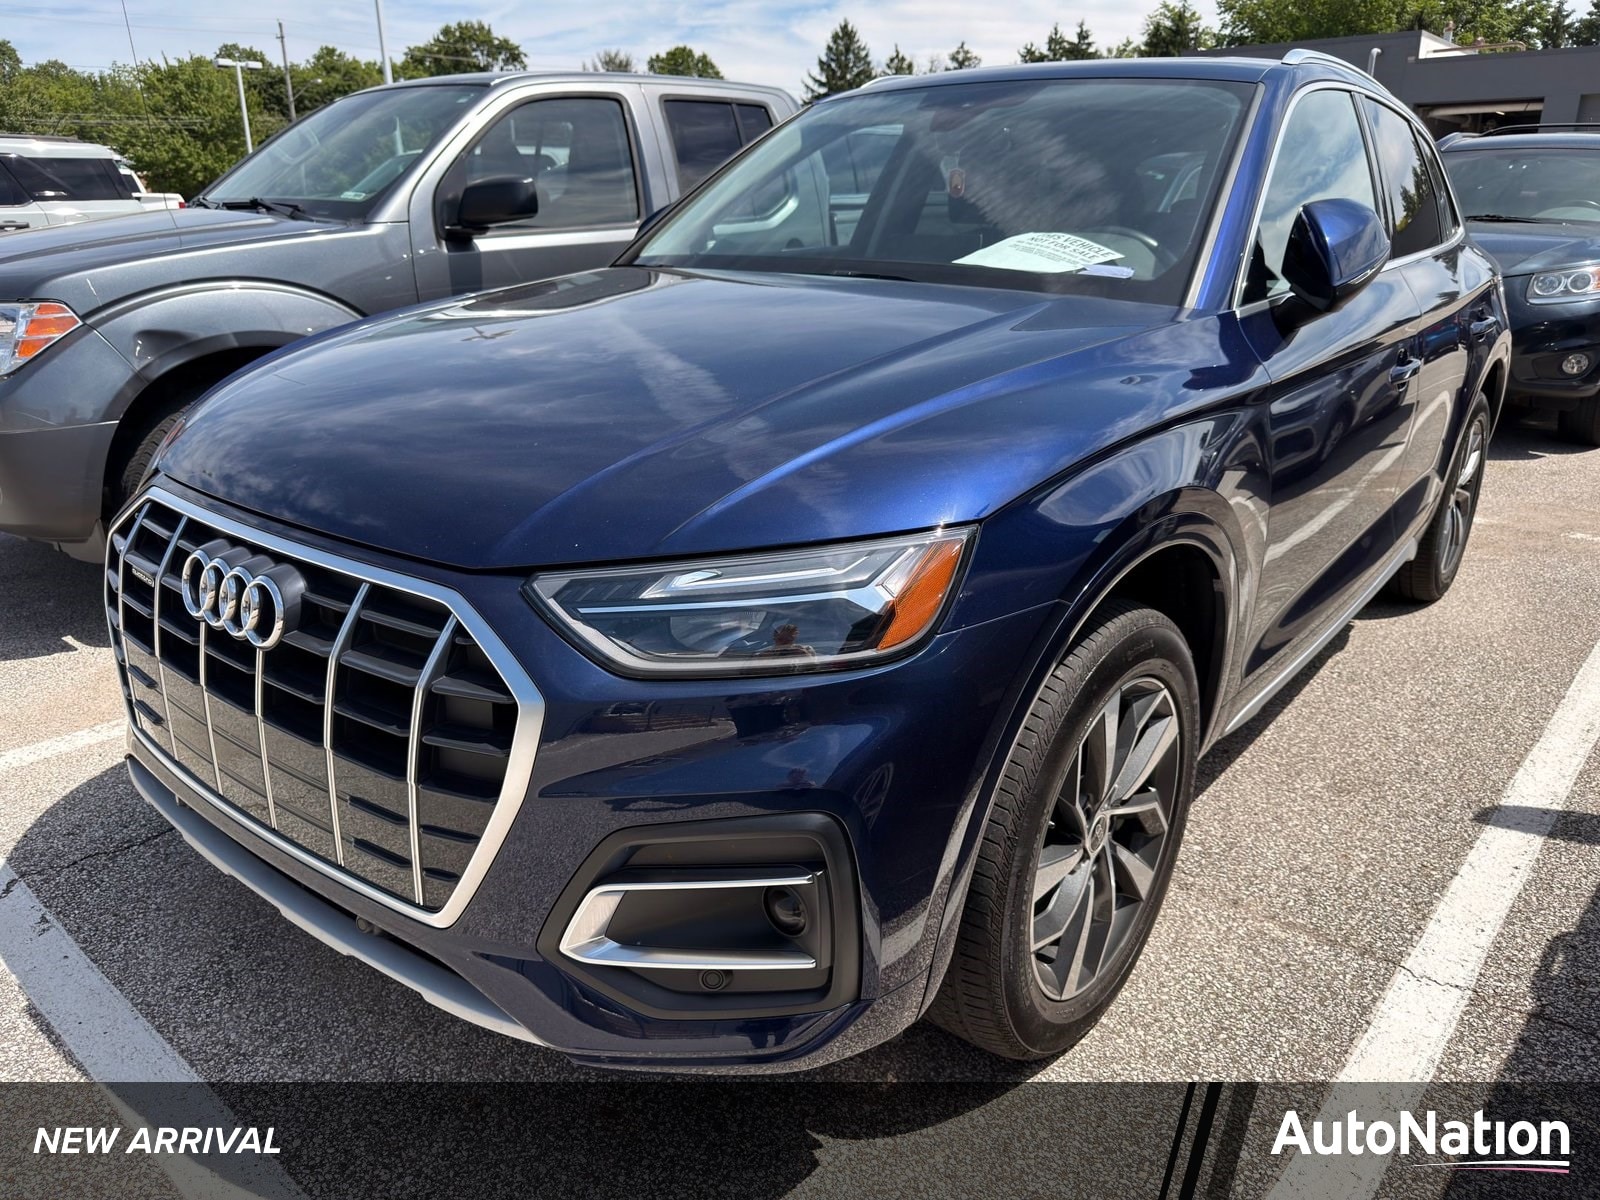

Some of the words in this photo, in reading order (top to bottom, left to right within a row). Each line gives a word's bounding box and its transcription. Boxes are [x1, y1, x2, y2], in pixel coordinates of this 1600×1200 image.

[1048, 240, 1070, 249] FOR
[1069, 248, 1099, 259] SALE
[1063, 236, 1116, 257] VEHICLE
